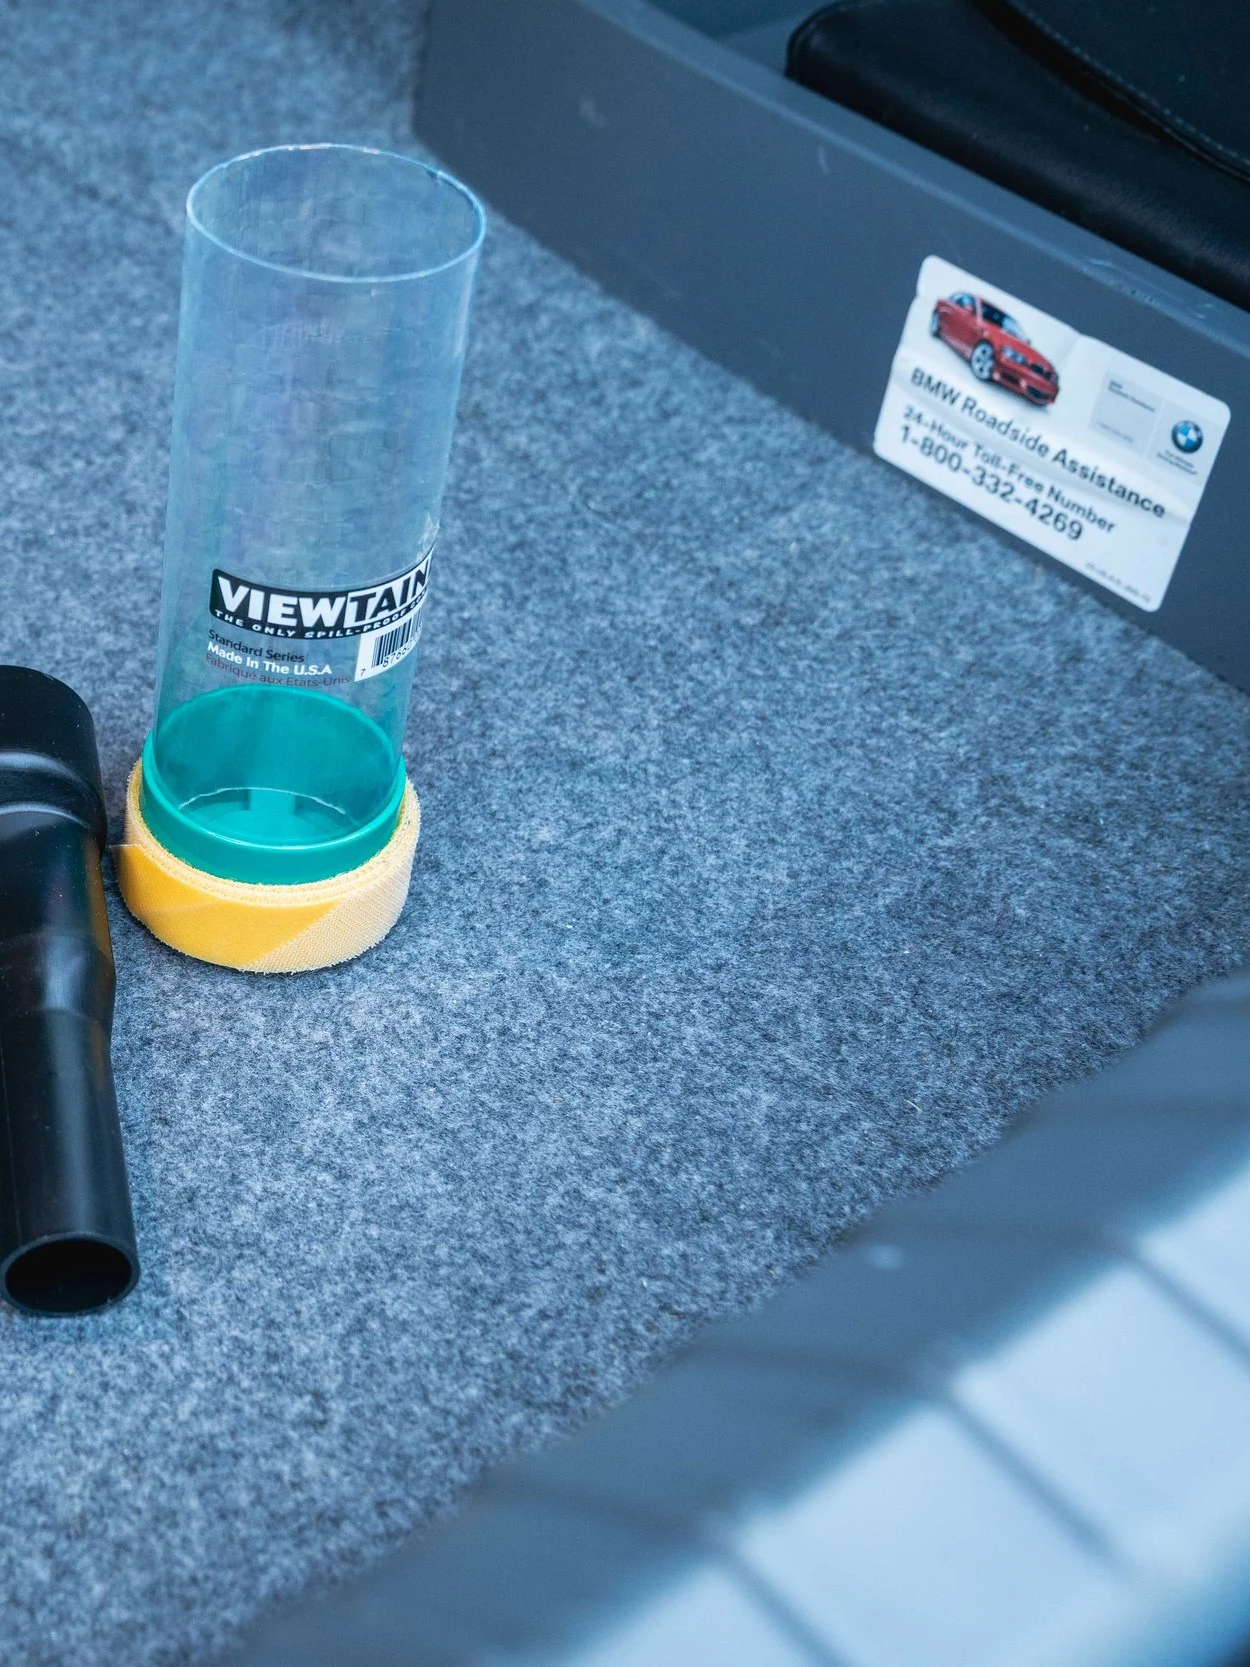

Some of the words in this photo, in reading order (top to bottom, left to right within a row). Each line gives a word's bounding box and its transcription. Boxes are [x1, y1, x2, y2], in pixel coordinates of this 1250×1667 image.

[911, 367, 961, 405] BMW
[961, 396, 1049, 458] Roadside
[1052, 448, 1166, 518] Assistance
[901, 424, 1084, 540] 1-800-332-4269
[903, 404, 968, 449] 24-Hour
[973, 440, 1044, 494] Toll-Free
[1048, 483, 1116, 534] Number
[214, 608, 244, 627] THE
[252, 624, 296, 638] ONLY
[304, 611, 407, 638] SPILL-PROOF
[207, 641, 242, 664] Made
[246, 657, 259, 669] In
[263, 661, 290, 674] The
[293, 665, 333, 675] U.S.A
[209, 629, 262, 657] Standard
[265, 650, 304, 662] Series
[206, 653, 258, 678] Fabrique
[260, 675, 283, 684] aux
